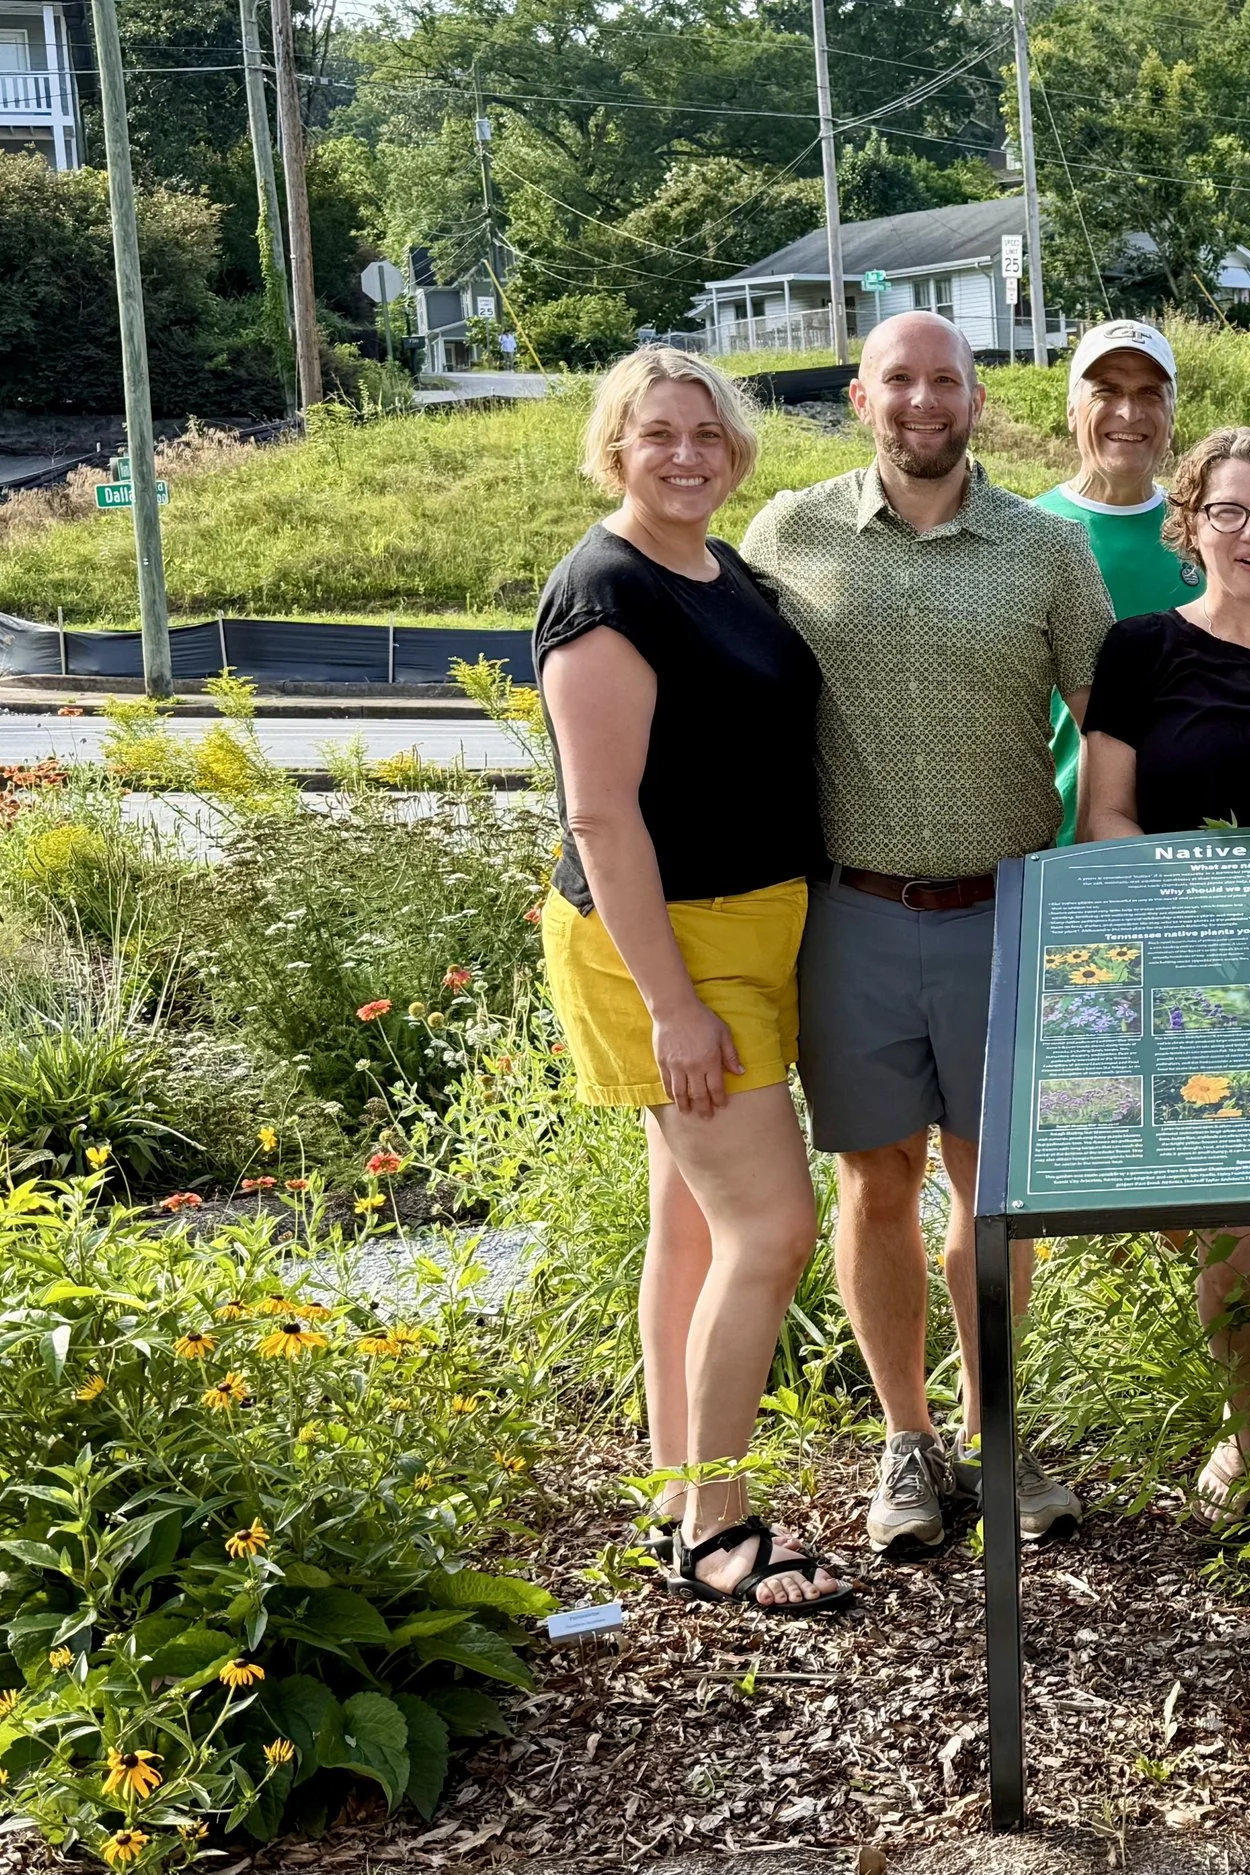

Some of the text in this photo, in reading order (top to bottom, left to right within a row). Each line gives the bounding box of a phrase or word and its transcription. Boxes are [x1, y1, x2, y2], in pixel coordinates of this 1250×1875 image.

[1005, 257, 1020, 273] 25
[480, 307, 494, 316] 25
[104, 485, 136, 504] Dalla
[1155, 844, 1247, 860] Native
[1160, 888, 1184, 896] Why
[1186, 886, 1223, 894] should
[1104, 932, 1162, 940] Tennessee
[1164, 929, 1198, 938] native
[1200, 928, 1234, 938] plants
